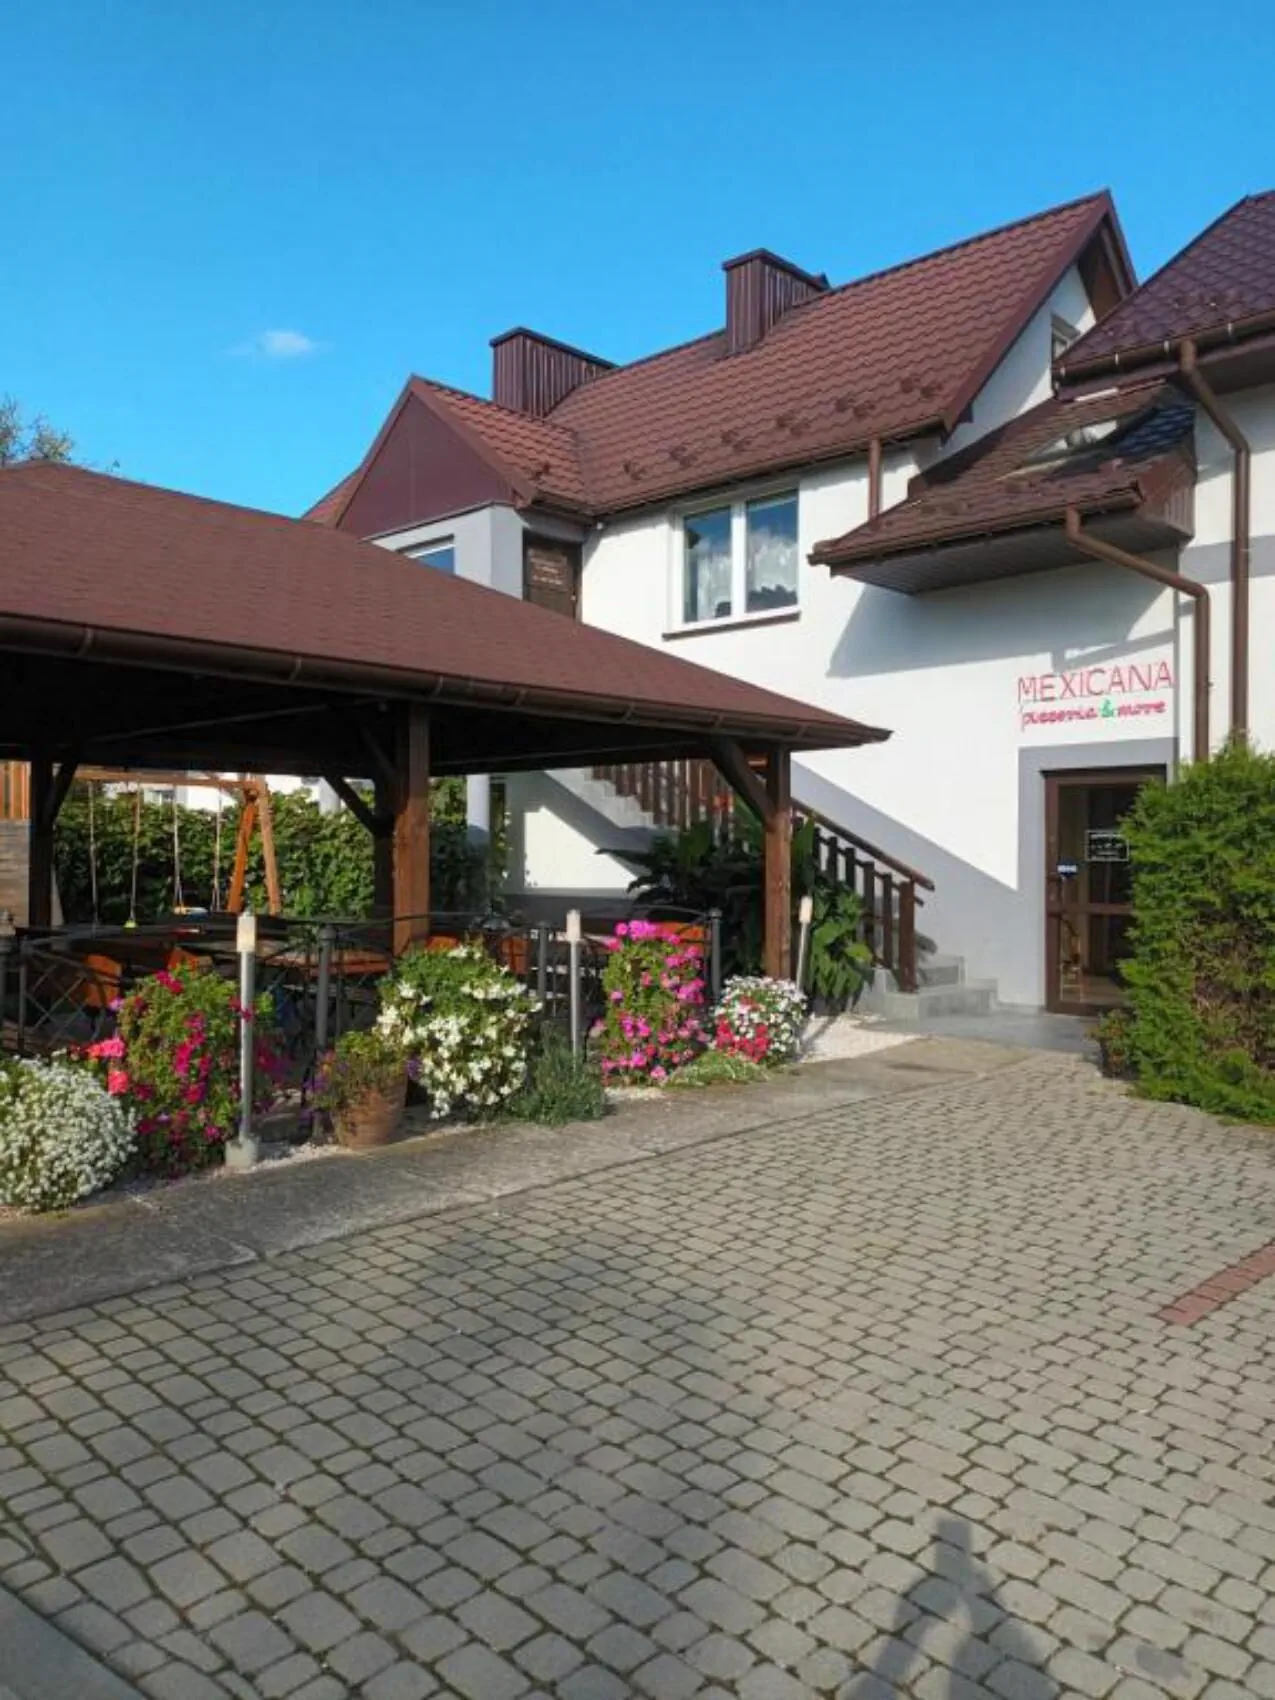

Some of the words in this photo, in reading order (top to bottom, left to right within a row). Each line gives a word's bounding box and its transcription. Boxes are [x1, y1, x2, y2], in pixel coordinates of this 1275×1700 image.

[1018, 660, 1174, 703] MEXICANA
[1101, 699, 1114, 718] &
[1117, 701, 1166, 718] more
